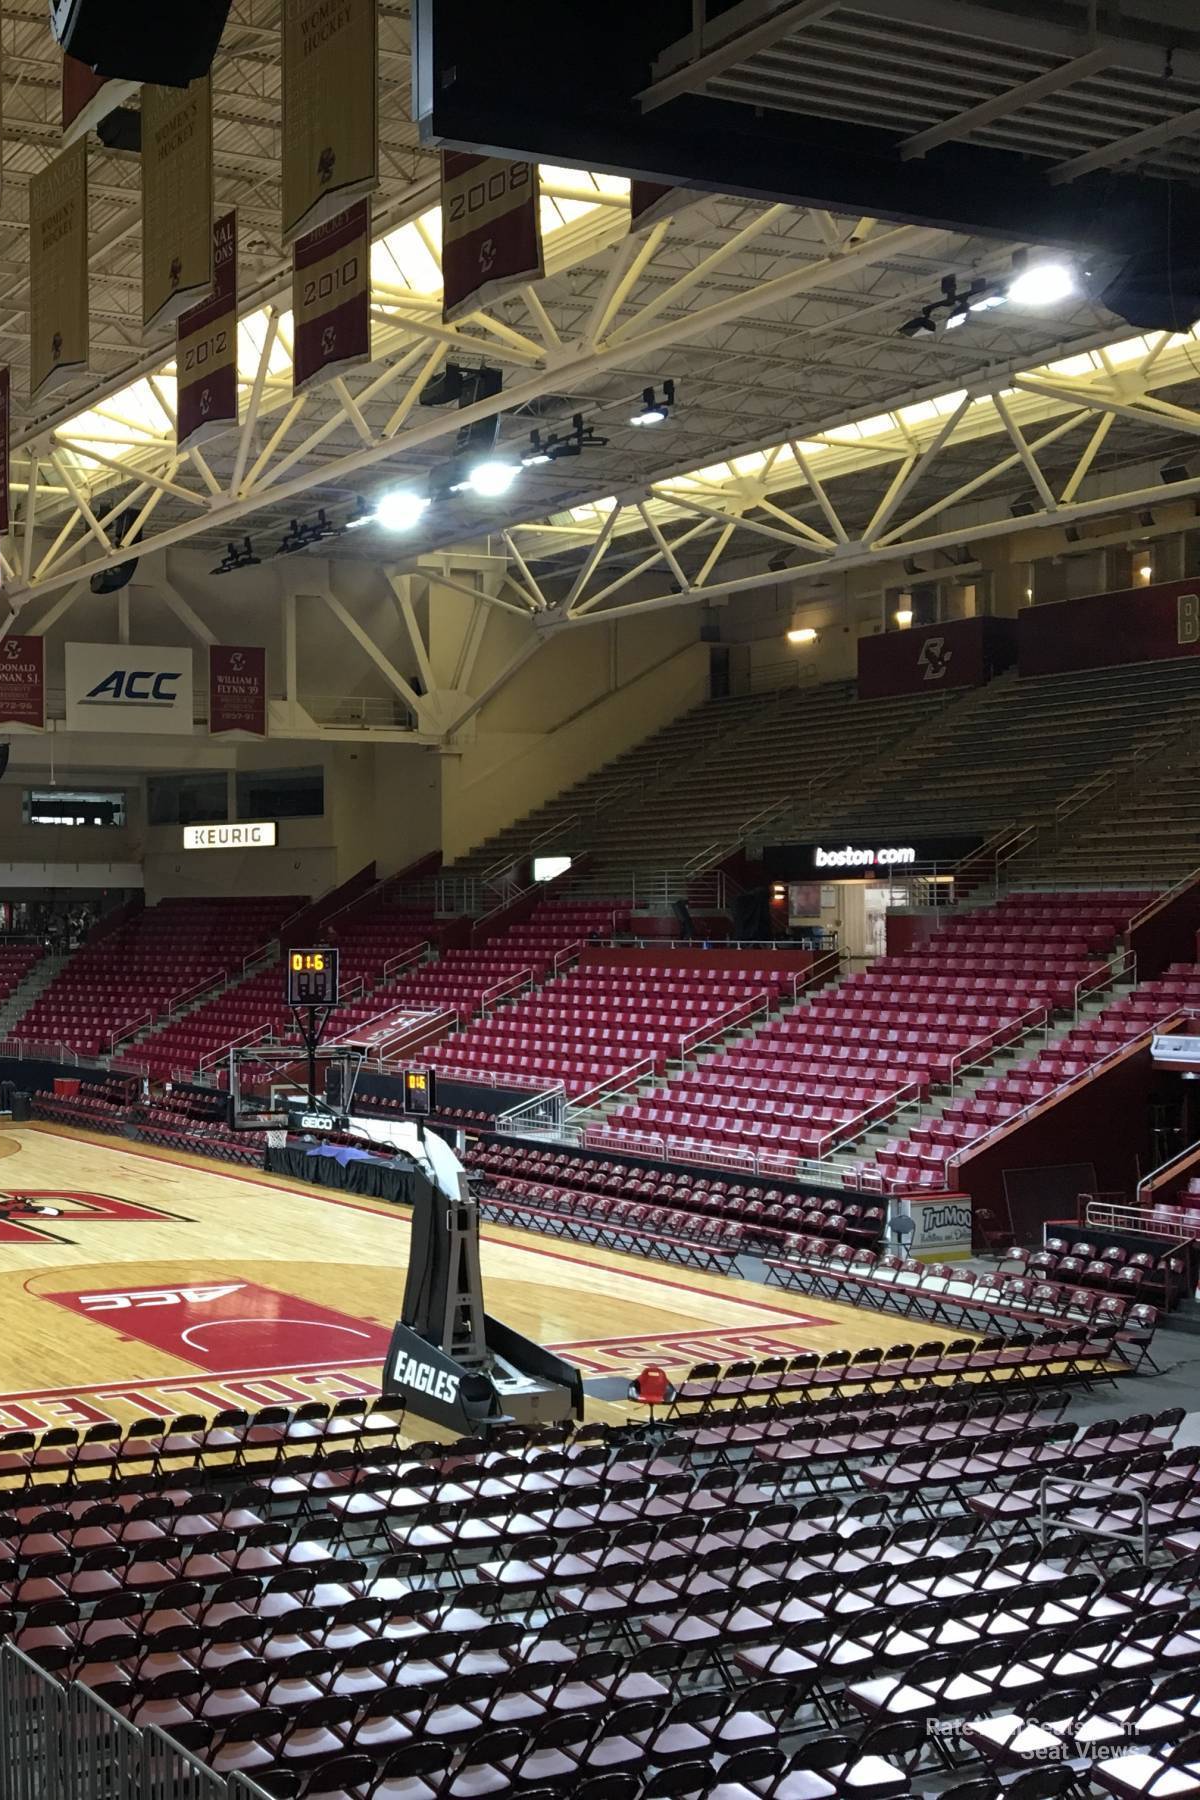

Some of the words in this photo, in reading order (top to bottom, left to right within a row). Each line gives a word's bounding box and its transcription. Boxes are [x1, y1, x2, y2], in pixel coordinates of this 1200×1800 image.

[304, 5, 352, 56] HOCKEY
[158, 122, 195, 161] HOCKEY
[449, 161, 529, 222] 2008
[304, 257, 358, 306] 2010
[184, 331, 227, 372] 2012
[86, 670, 183, 700] ACC
[217, 675, 251, 684] WILLIAM
[217, 685, 245, 694] FLYNN
[195, 827, 261, 845] KEURIG
[815, 845, 916, 867] boston.com
[301, 1116, 333, 1130] GEICO
[79, 1284, 248, 1311] ACC
[559, 1334, 821, 1376] BOST
[393, 1350, 460, 1404] EAGLES
